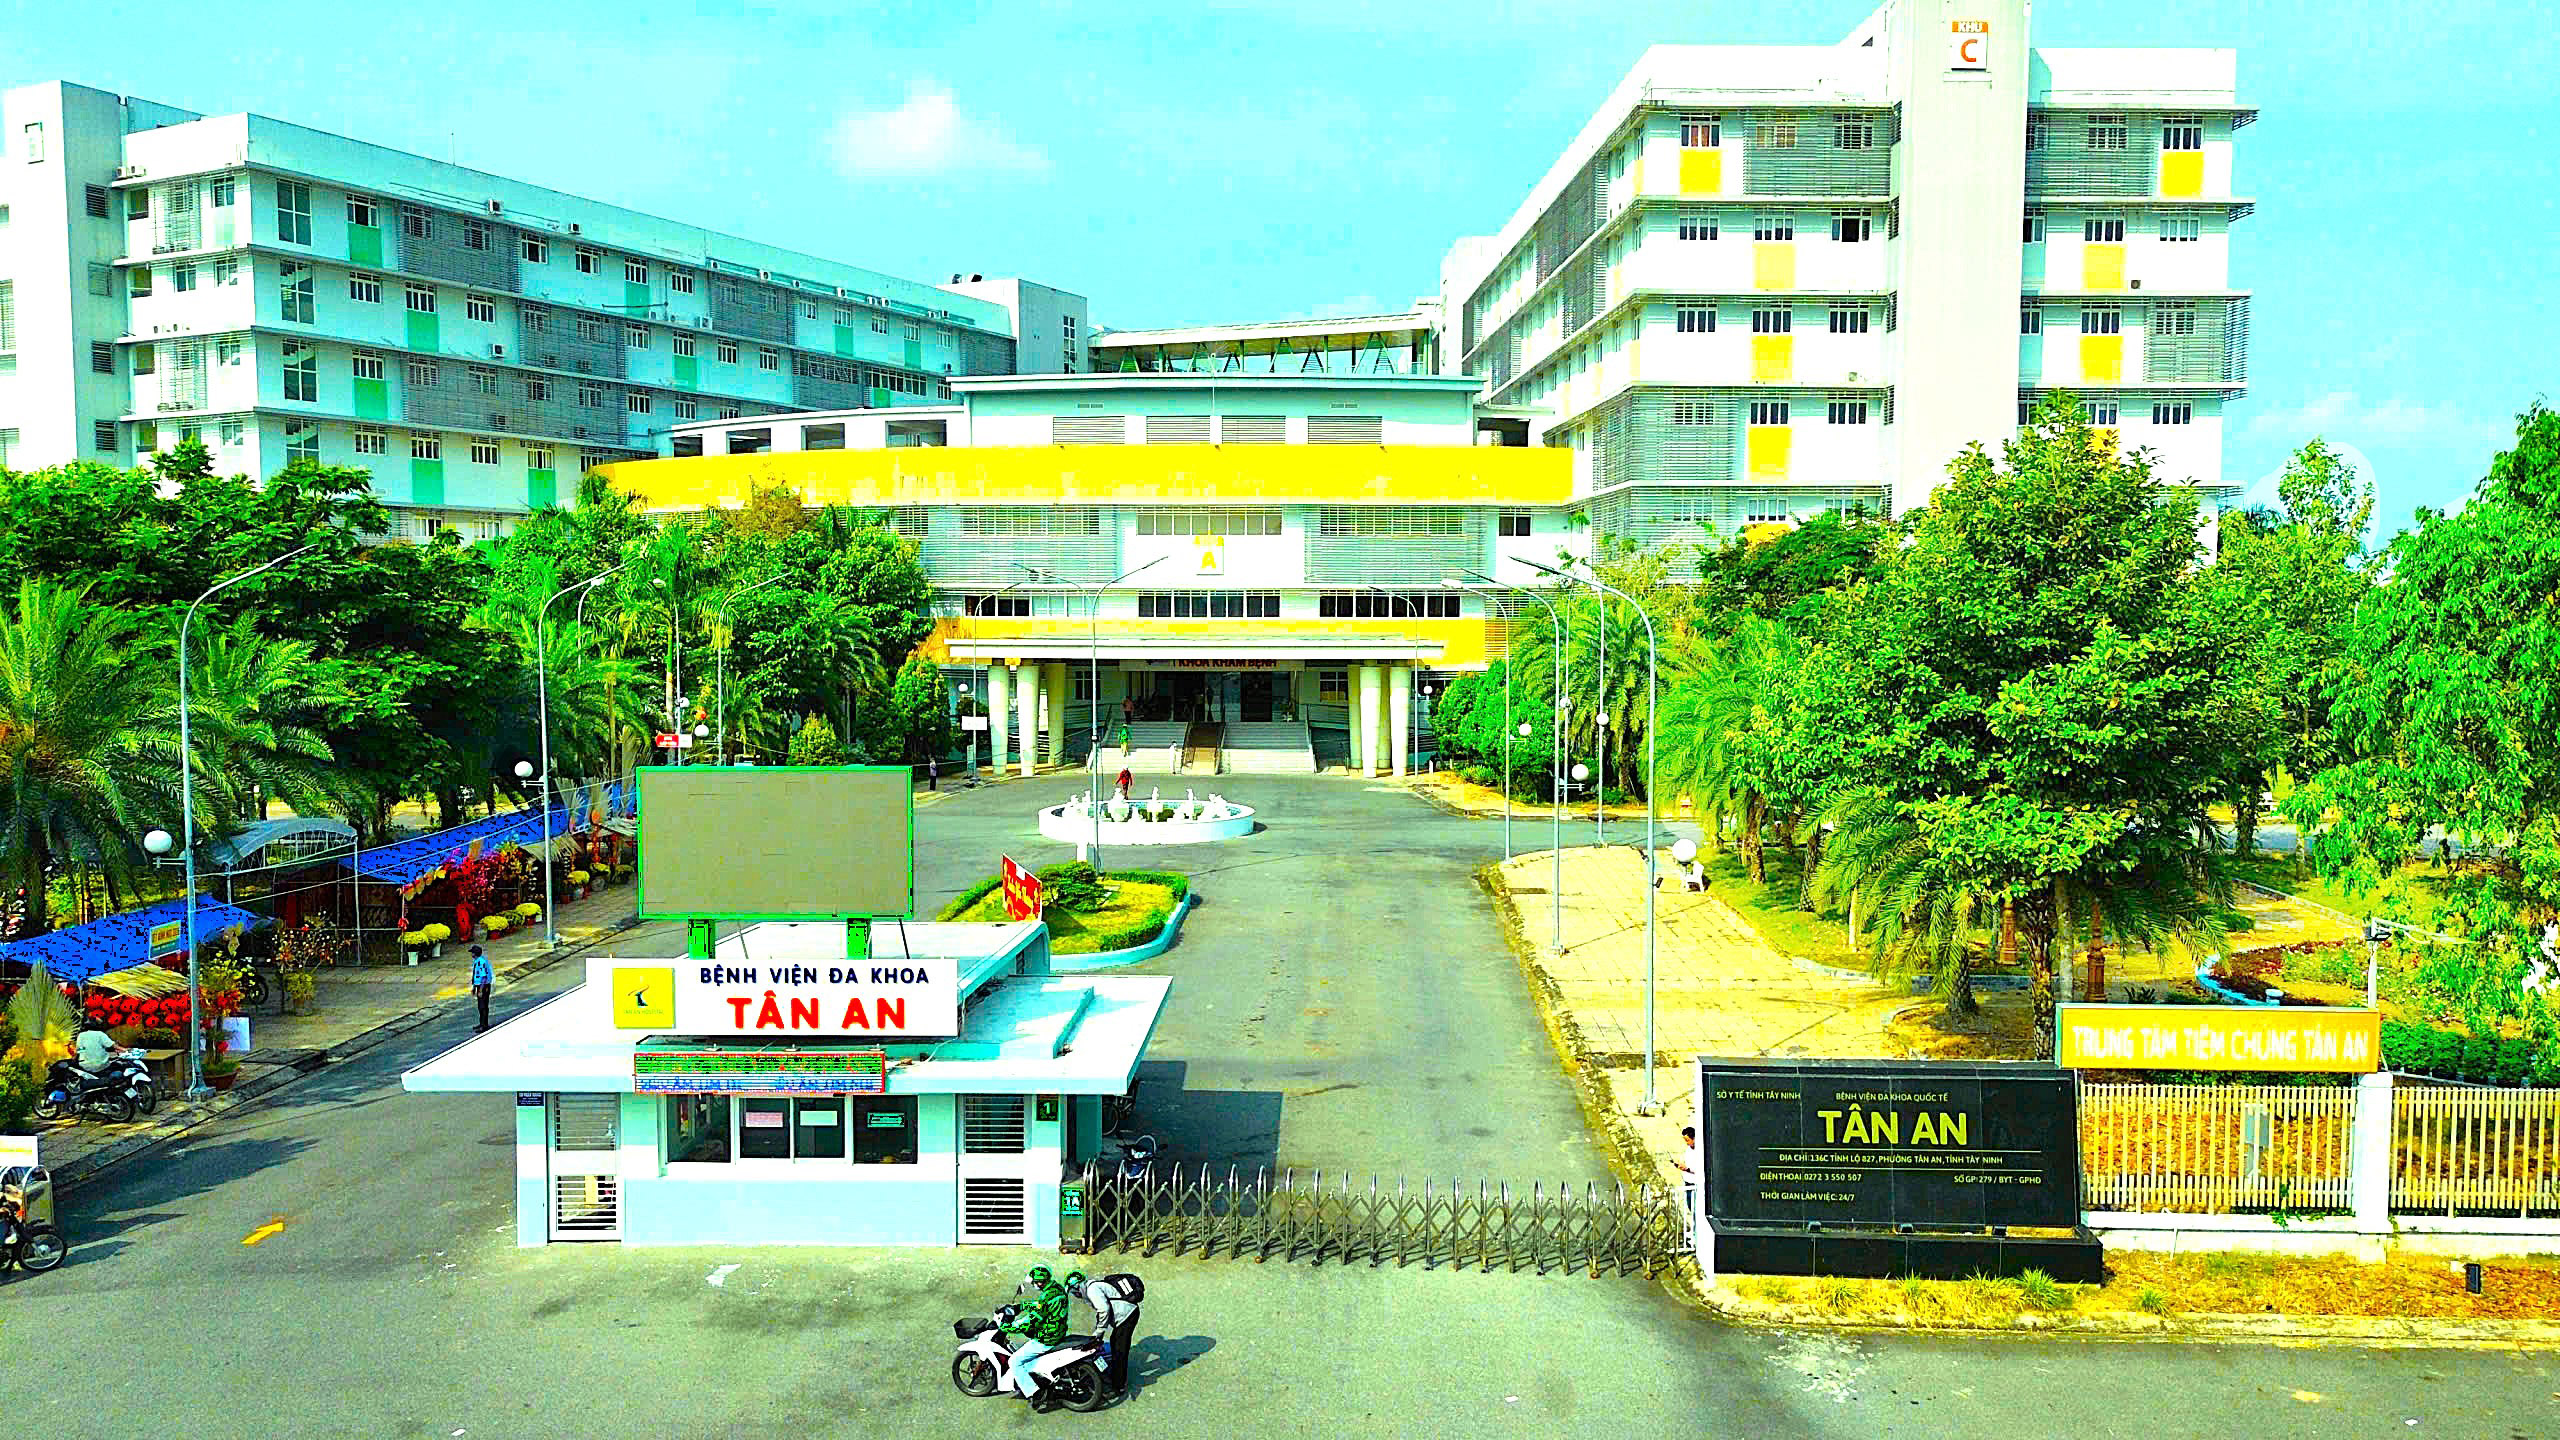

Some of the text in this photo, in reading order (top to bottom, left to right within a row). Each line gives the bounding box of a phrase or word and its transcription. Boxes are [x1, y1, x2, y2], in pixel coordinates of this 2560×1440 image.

[1960, 21, 1982, 32] KHU
[1961, 39, 1978, 62] C
[1201, 552, 1216, 568] A
[1178, 659, 1209, 668] KHOA
[700, 963, 929, 987] BỆNH VIỆN ĐA KHOA
[726, 990, 905, 1030] TÂN AN
[2072, 1025, 2134, 1059] TRUNG
[2140, 1023, 2177, 1060] TÂM
[2343, 1030, 2369, 1062] AN
[1728, 1091, 1734, 1099] Y
[1765, 1090, 1779, 1099] TÂY
[1780, 1091, 1801, 1100] NINH
[1890, 1093, 1912, 1102] KHOA
[1913, 1091, 1937, 1102] QUỐC
[1043, 1102, 1051, 1114] 1
[1817, 1103, 1967, 1146] TÂN AN
[1982, 1156, 2003, 1165] NINH
[1804, 1173, 1822, 1181] 0272
[1824, 1173, 1830, 1181] 3
[1831, 1173, 1845, 1182] 550
[1847, 1173, 1862, 1182] 507
[1998, 1176, 2013, 1184] BYT
[1781, 1192, 1800, 1200] GIAN
[1838, 1193, 1855, 1202] 24/7
